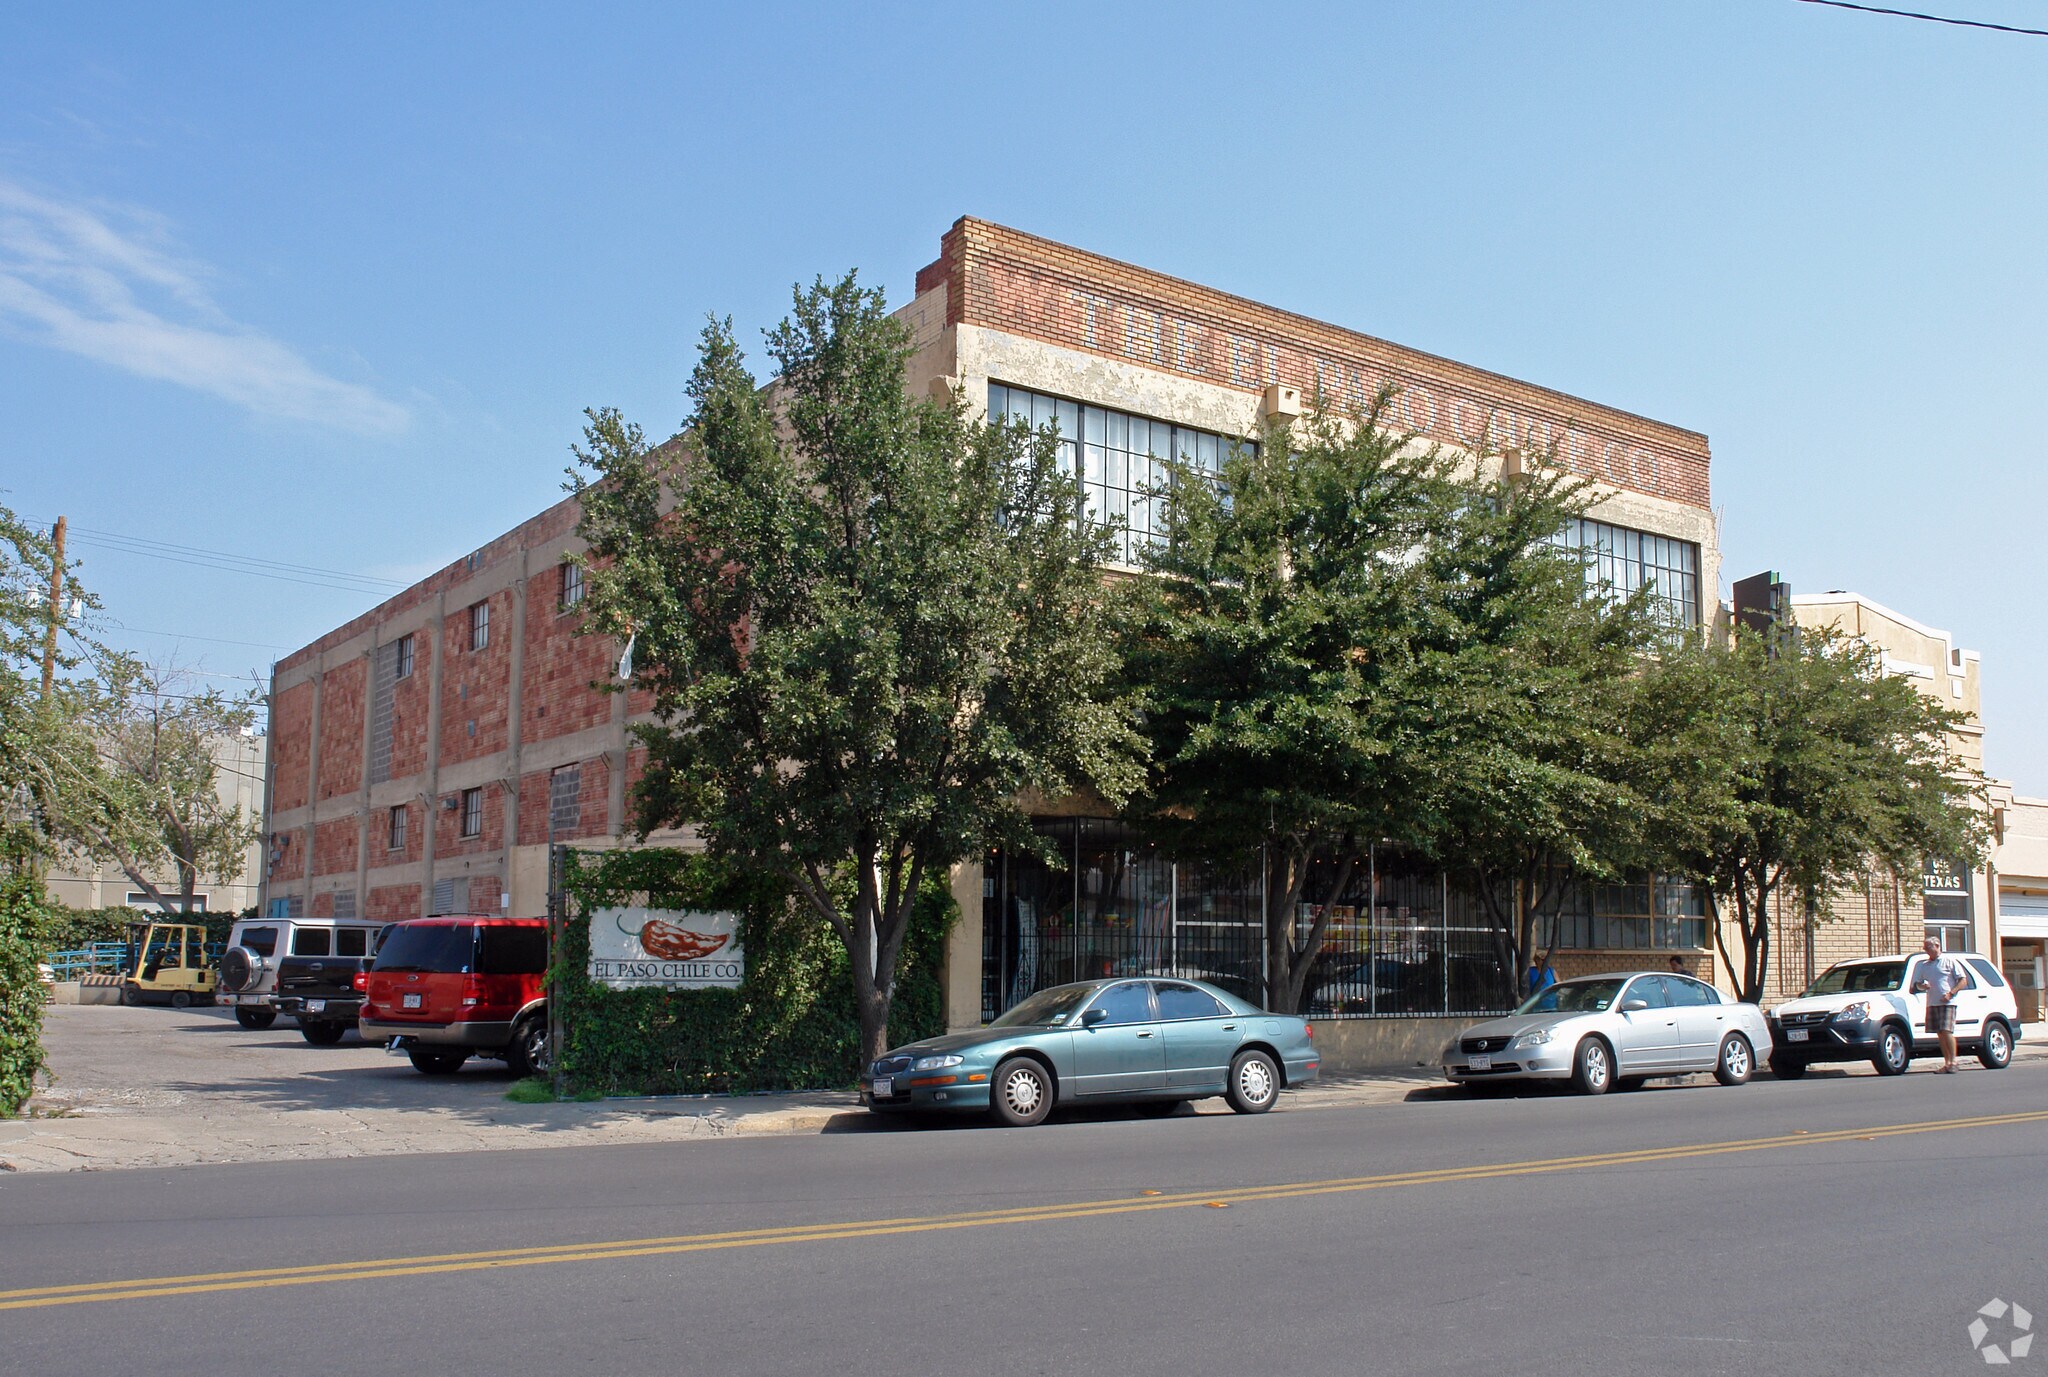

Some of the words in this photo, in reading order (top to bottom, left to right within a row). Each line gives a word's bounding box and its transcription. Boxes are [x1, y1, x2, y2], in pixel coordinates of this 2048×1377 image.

[1068, 289, 1206, 376] THE
[1923, 874, 1961, 889] TEXAS
[595, 963, 614, 977] EL
[617, 963, 658, 978] PASO
[662, 963, 710, 978] CHILE
[715, 964, 740, 978] CO.
